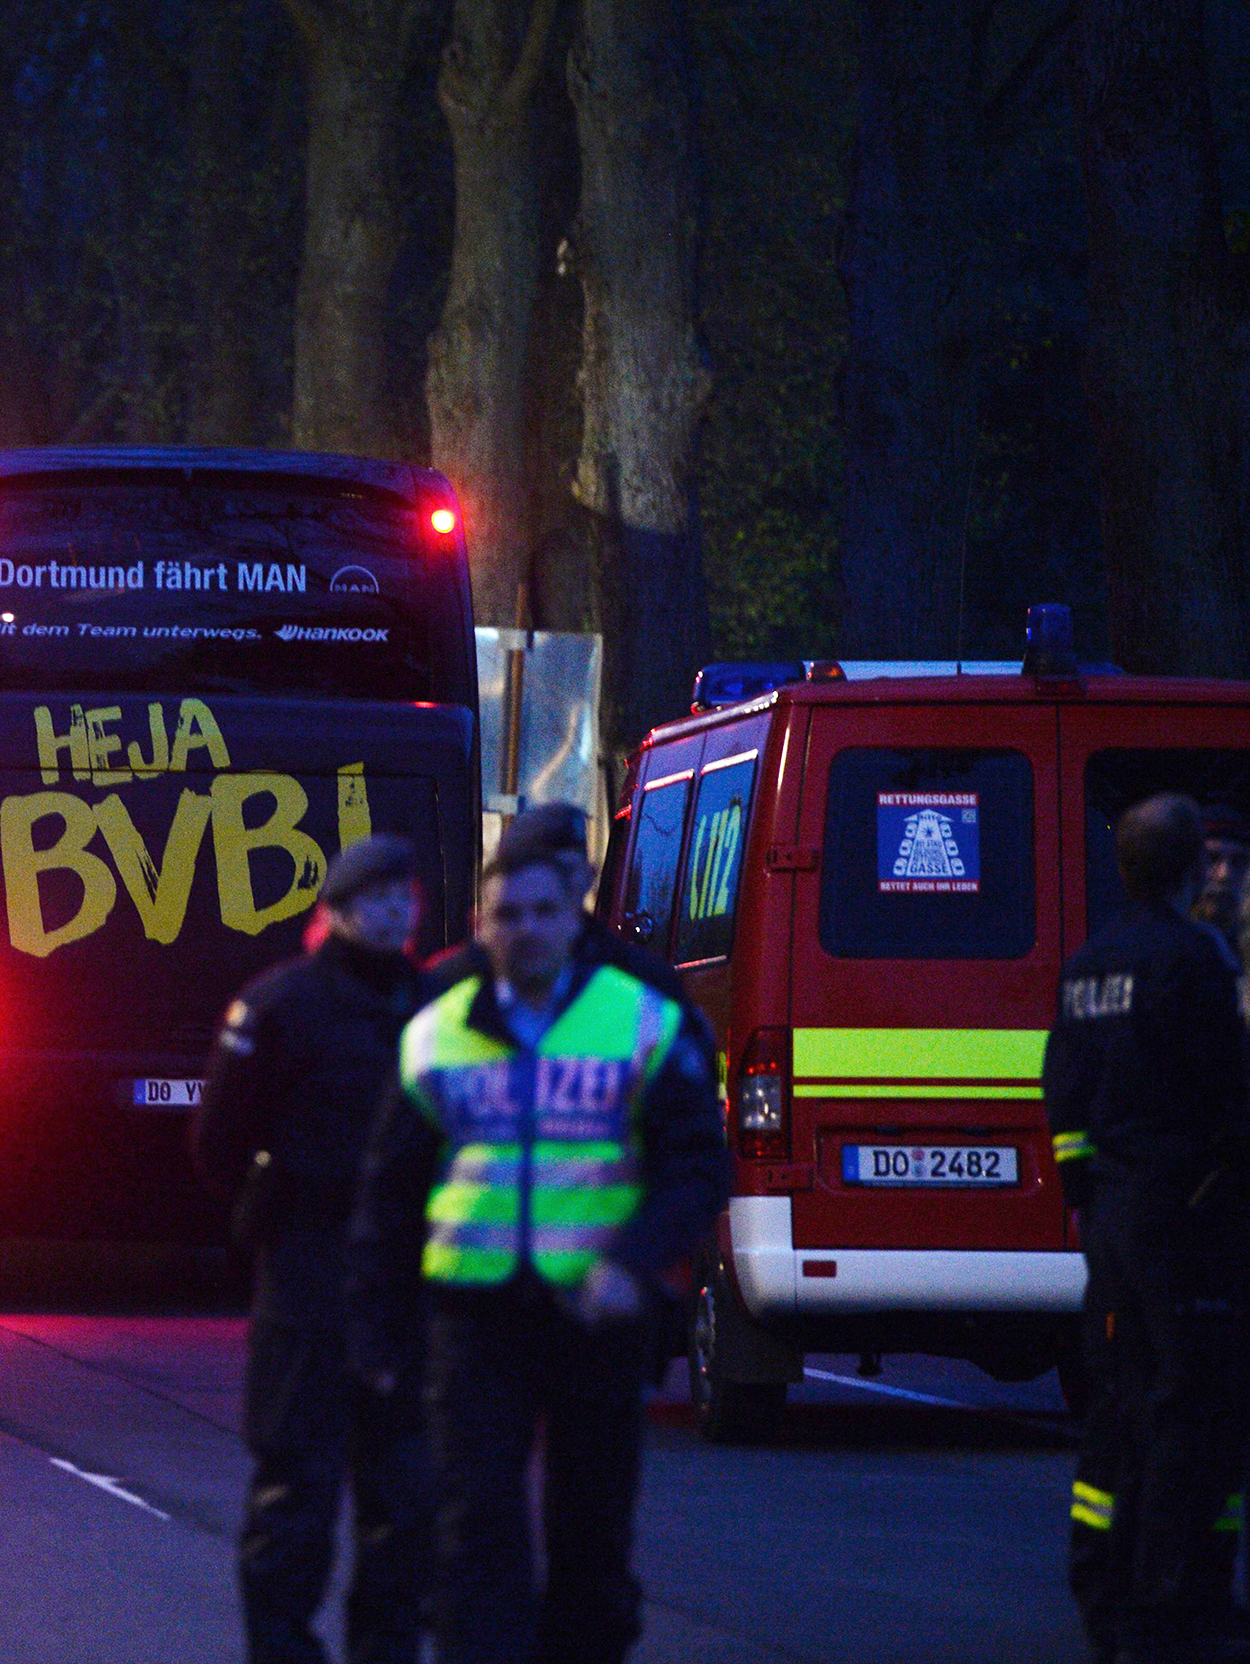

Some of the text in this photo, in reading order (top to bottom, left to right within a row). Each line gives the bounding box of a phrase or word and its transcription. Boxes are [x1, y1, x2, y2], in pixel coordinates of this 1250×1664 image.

[153, 559, 229, 592] fährt
[237, 562, 307, 593] MAN
[334, 583, 376, 594] MAN
[22, 621, 70, 637] dem
[77, 622, 138, 639] Team
[144, 623, 263, 643] unterwegs.
[34, 697, 232, 787] HEJA
[878, 794, 977, 806] RETTUNGSGASSE
[873, 1150, 1002, 1178] DO 2482
